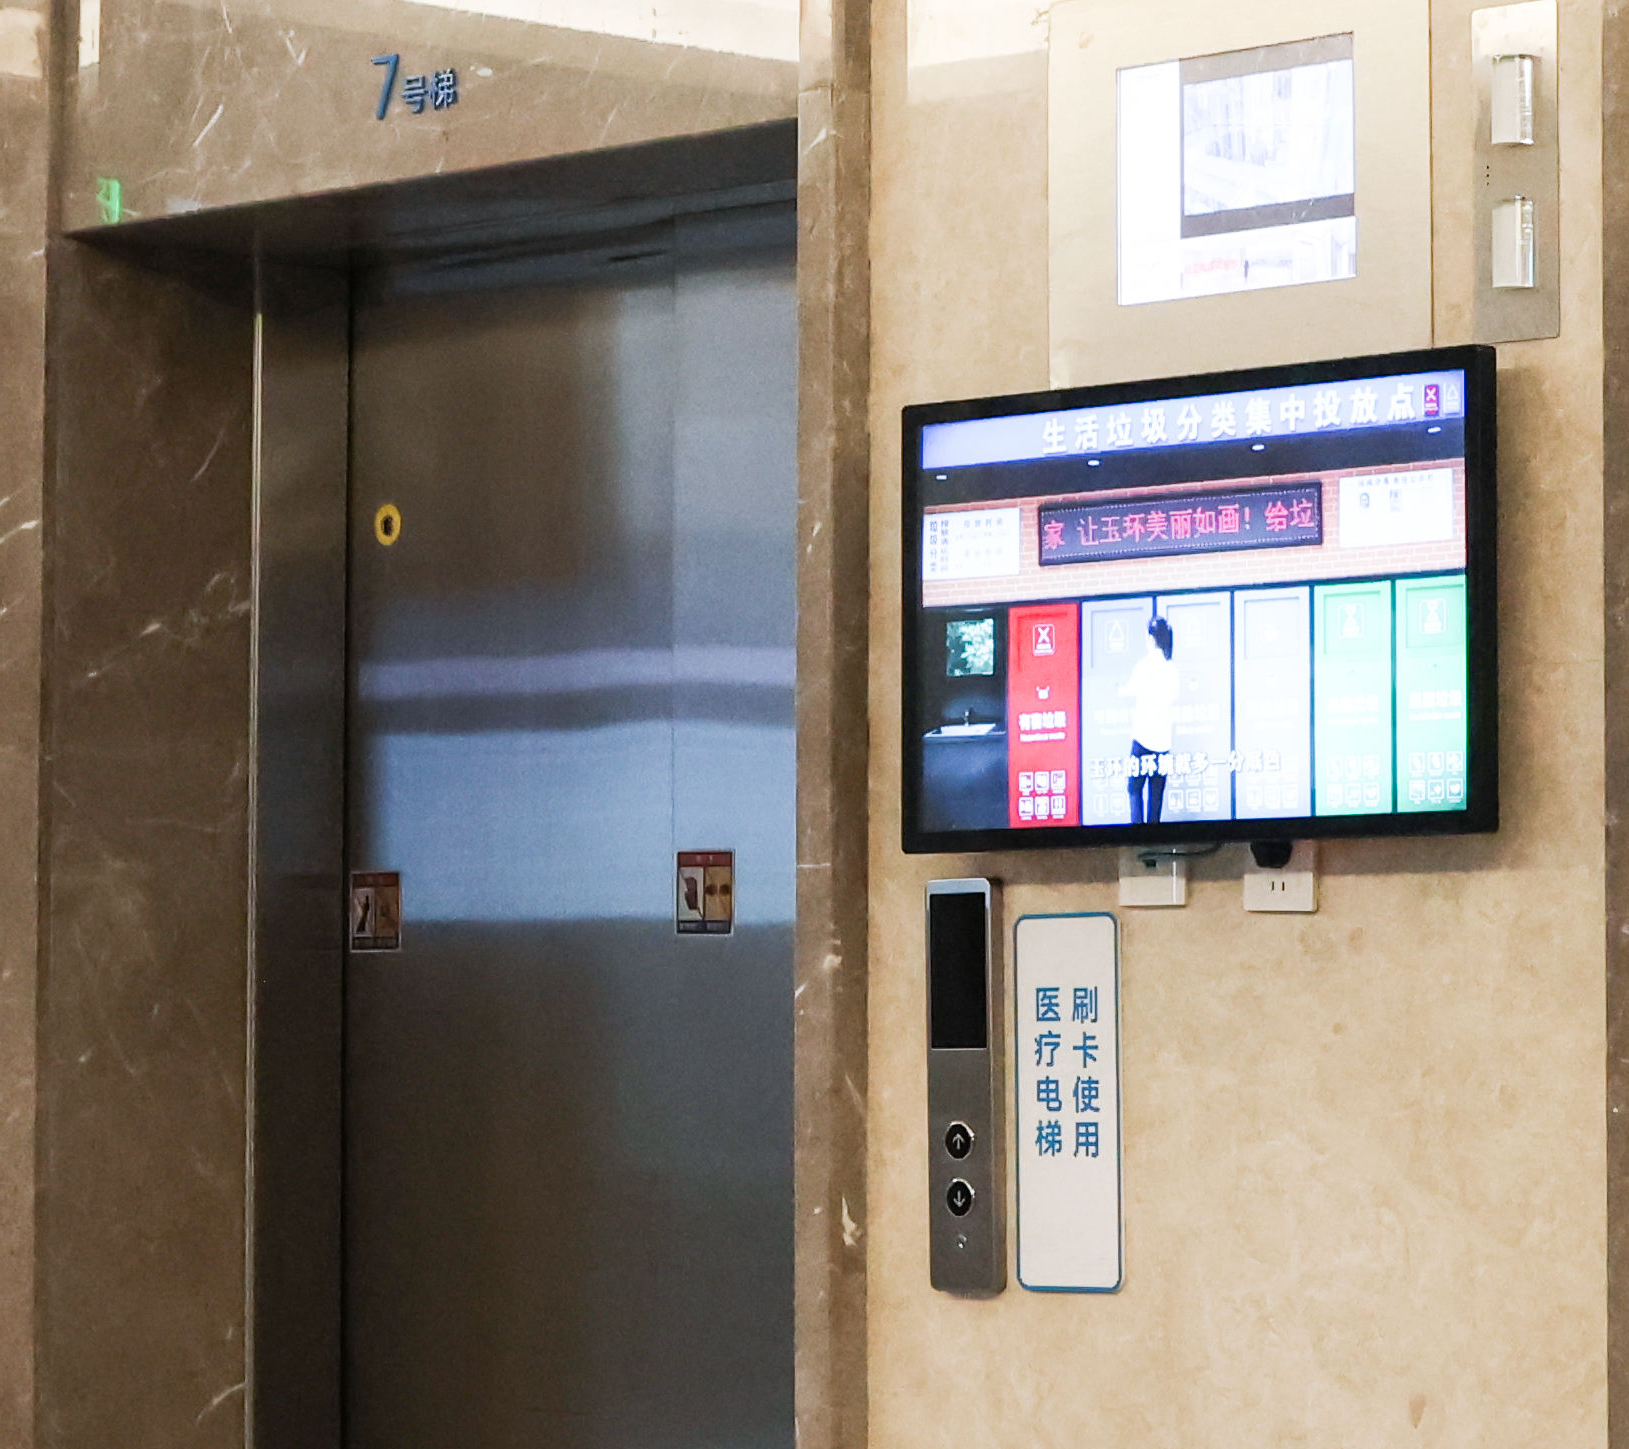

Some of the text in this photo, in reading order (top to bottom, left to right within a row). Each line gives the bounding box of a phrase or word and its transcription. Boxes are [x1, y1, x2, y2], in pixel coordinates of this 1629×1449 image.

[370, 53, 460, 120] 7号梯
[1041, 383, 1416, 455] 生活垃圾分类集中投放点
[1033, 986, 1063, 1158] 医疗电梯
[1071, 985, 1101, 1159] 刷卡使用
